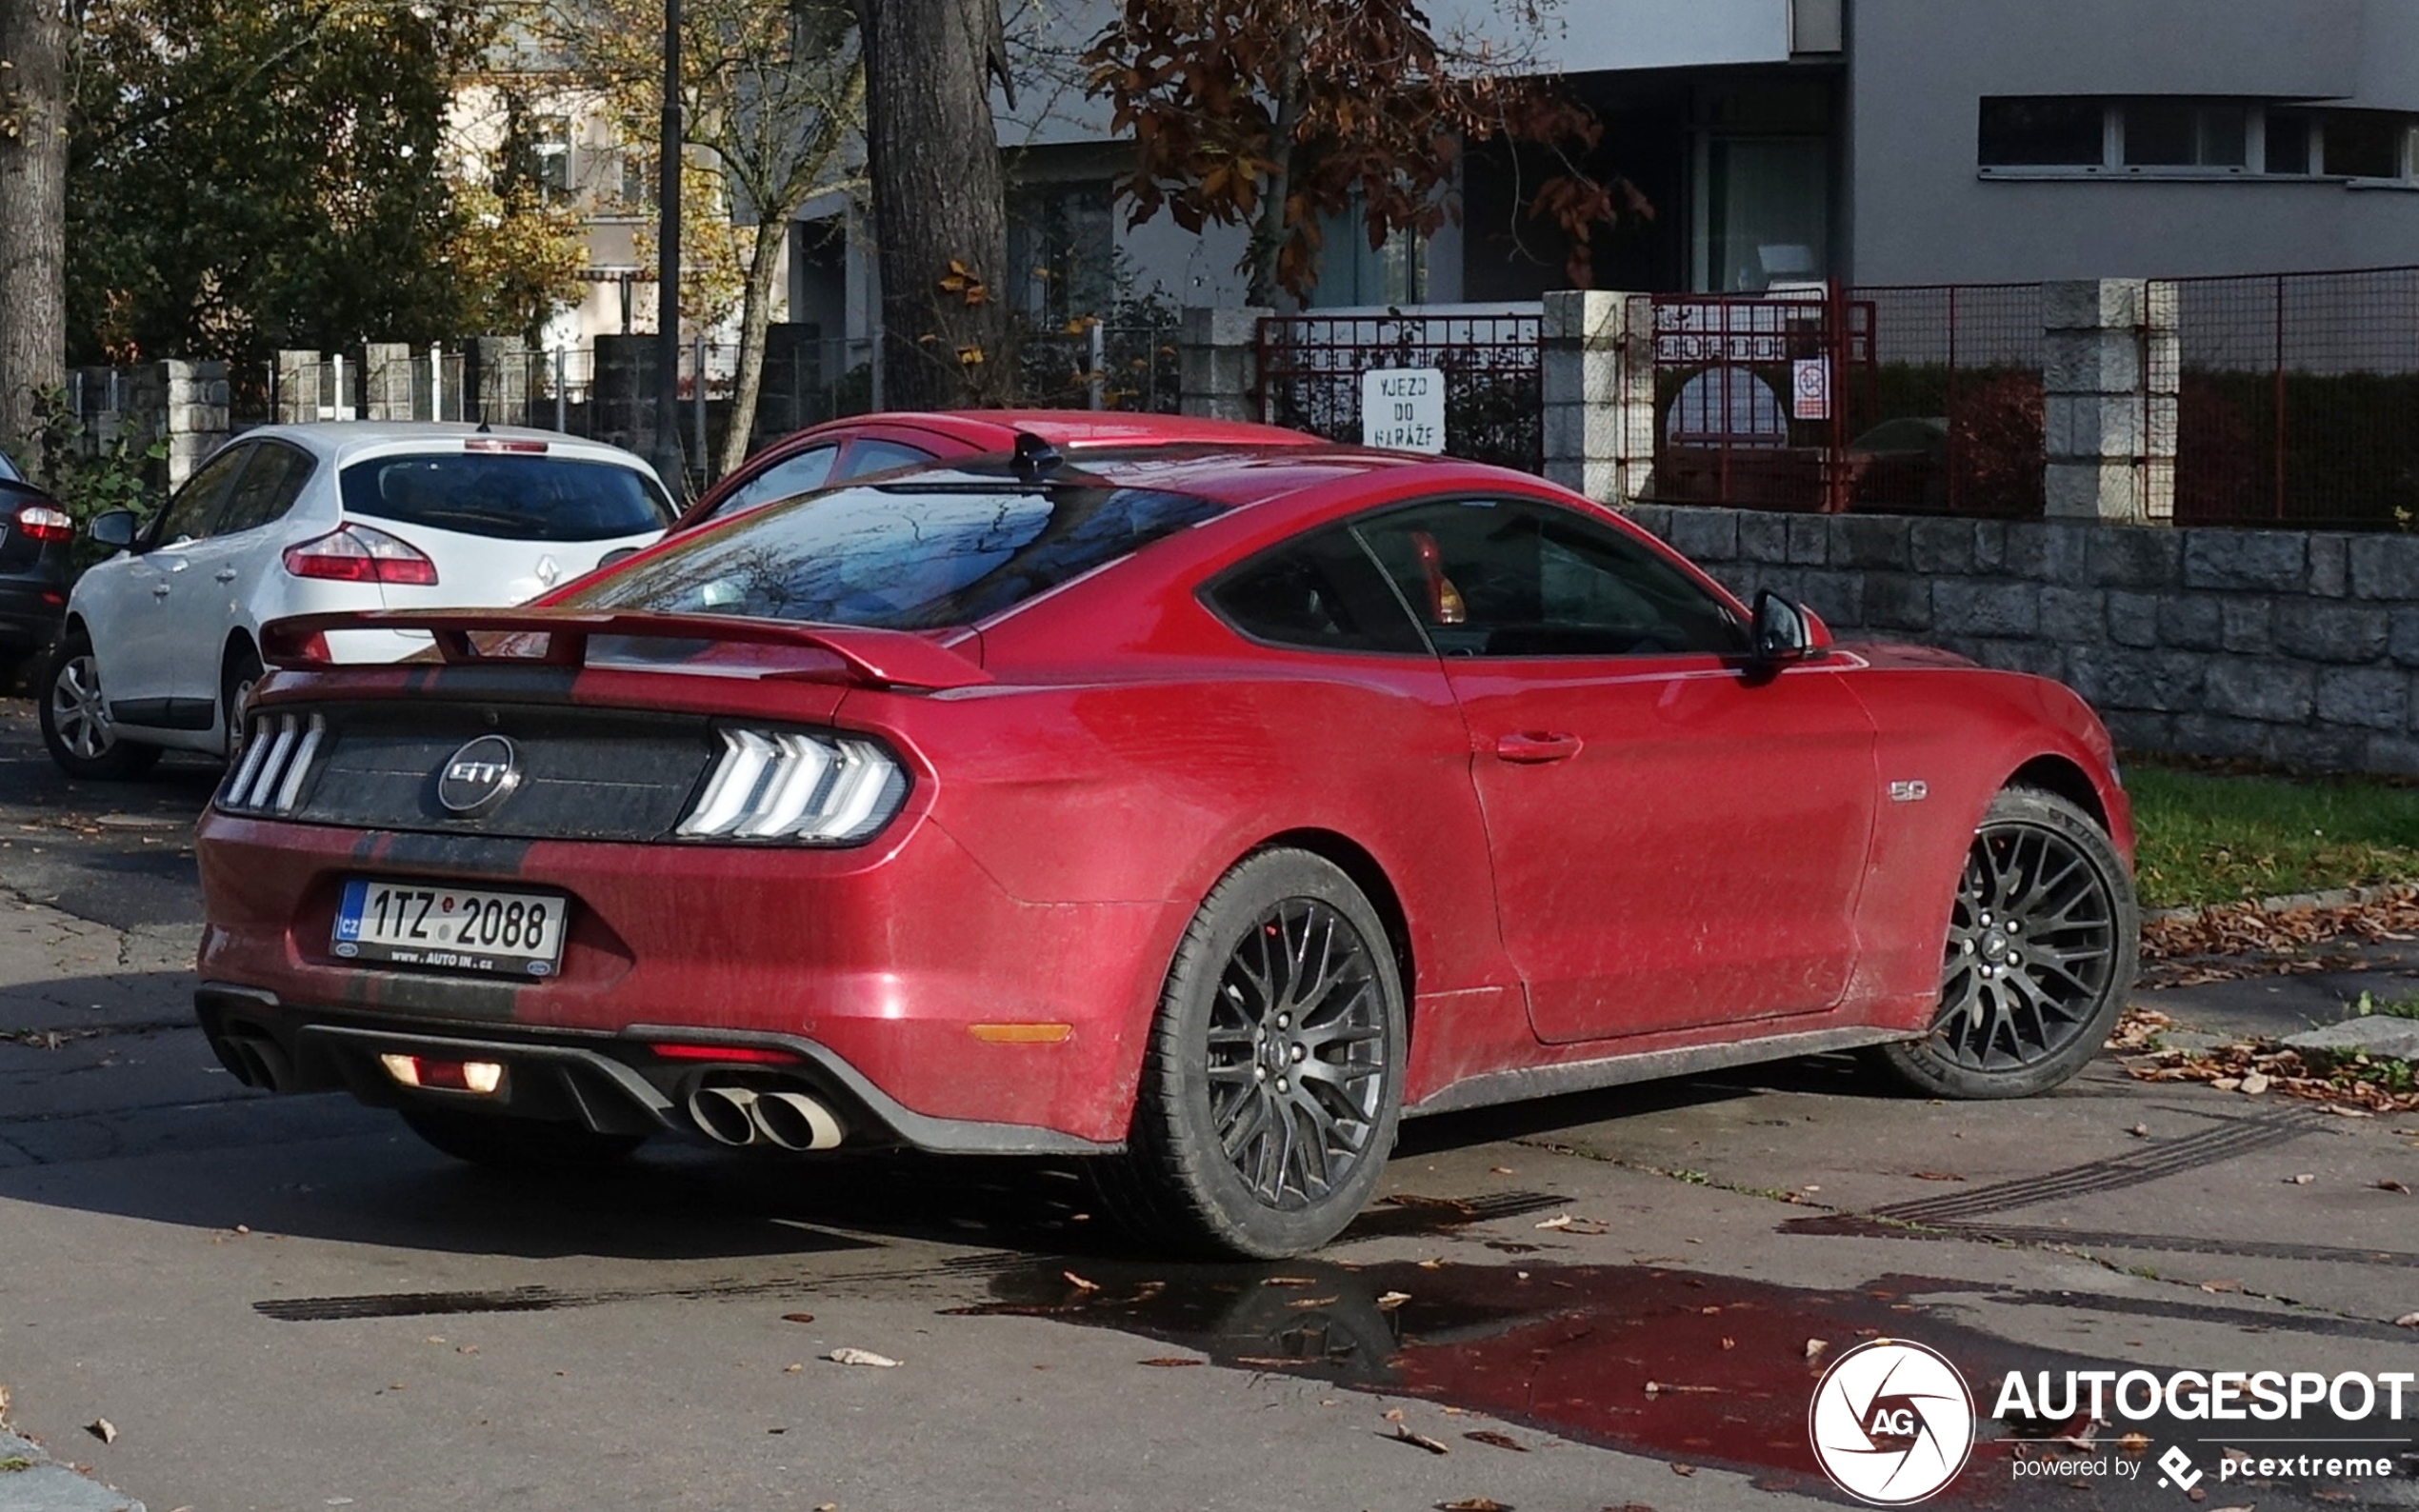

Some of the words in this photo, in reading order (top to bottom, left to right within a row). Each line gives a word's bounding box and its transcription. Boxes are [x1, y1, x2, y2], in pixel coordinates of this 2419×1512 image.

[1394, 403, 1413, 421] DO
[450, 762, 507, 783] GT
[341, 919, 358, 934] CZ
[374, 889, 435, 938] 1TZ
[456, 898, 547, 949] 2088
